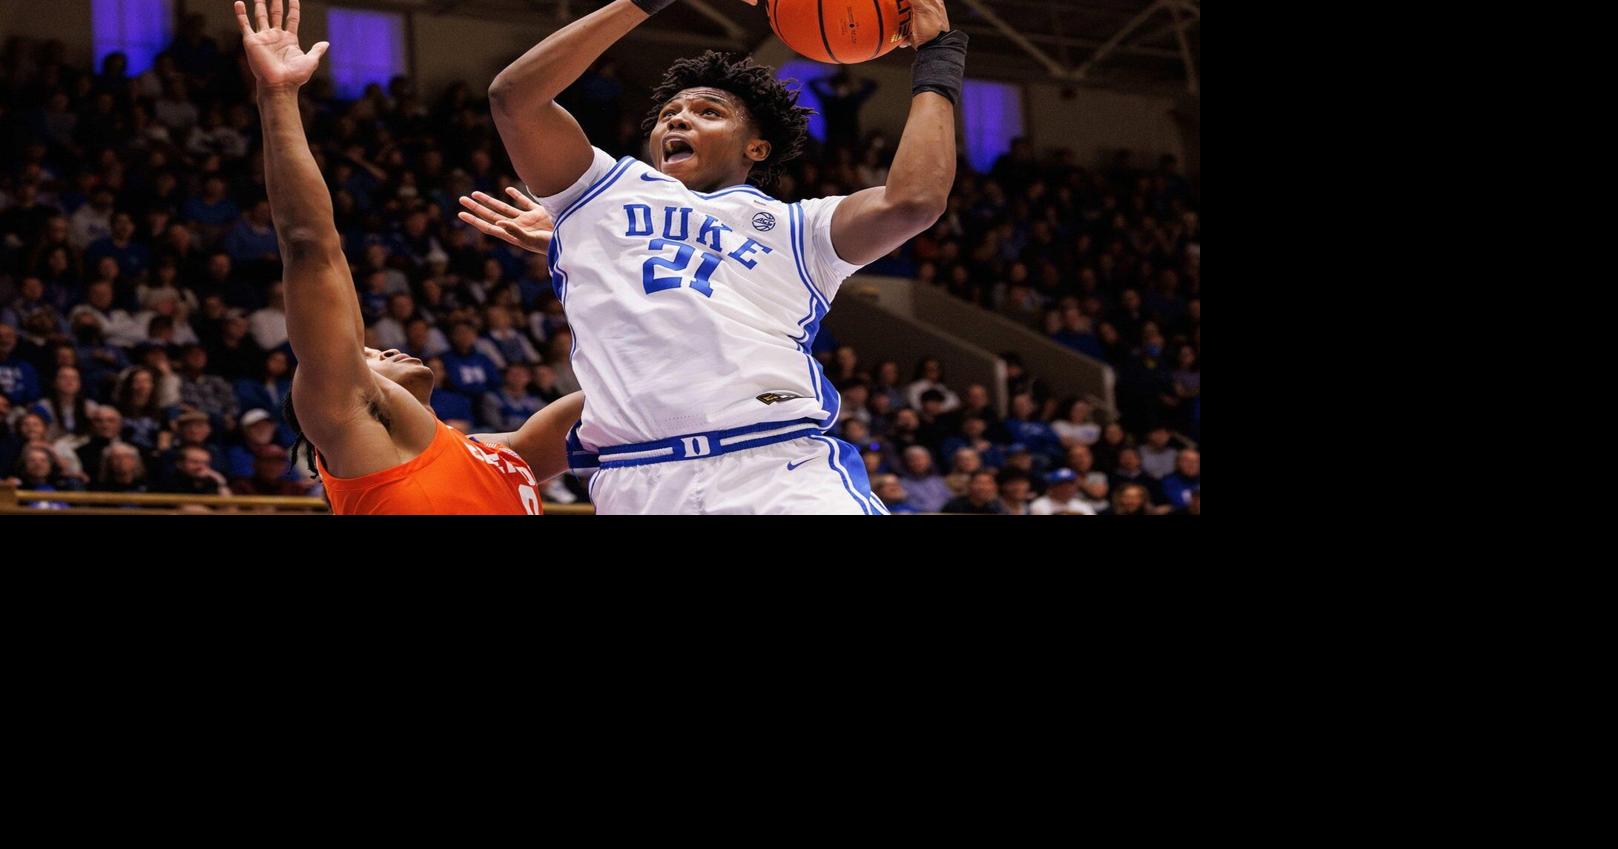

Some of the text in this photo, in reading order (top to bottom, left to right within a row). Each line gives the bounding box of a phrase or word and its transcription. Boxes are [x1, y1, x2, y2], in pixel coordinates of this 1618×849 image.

[623, 203, 773, 270] DUKE
[642, 237, 722, 298] 21
[680, 435, 711, 458] D
